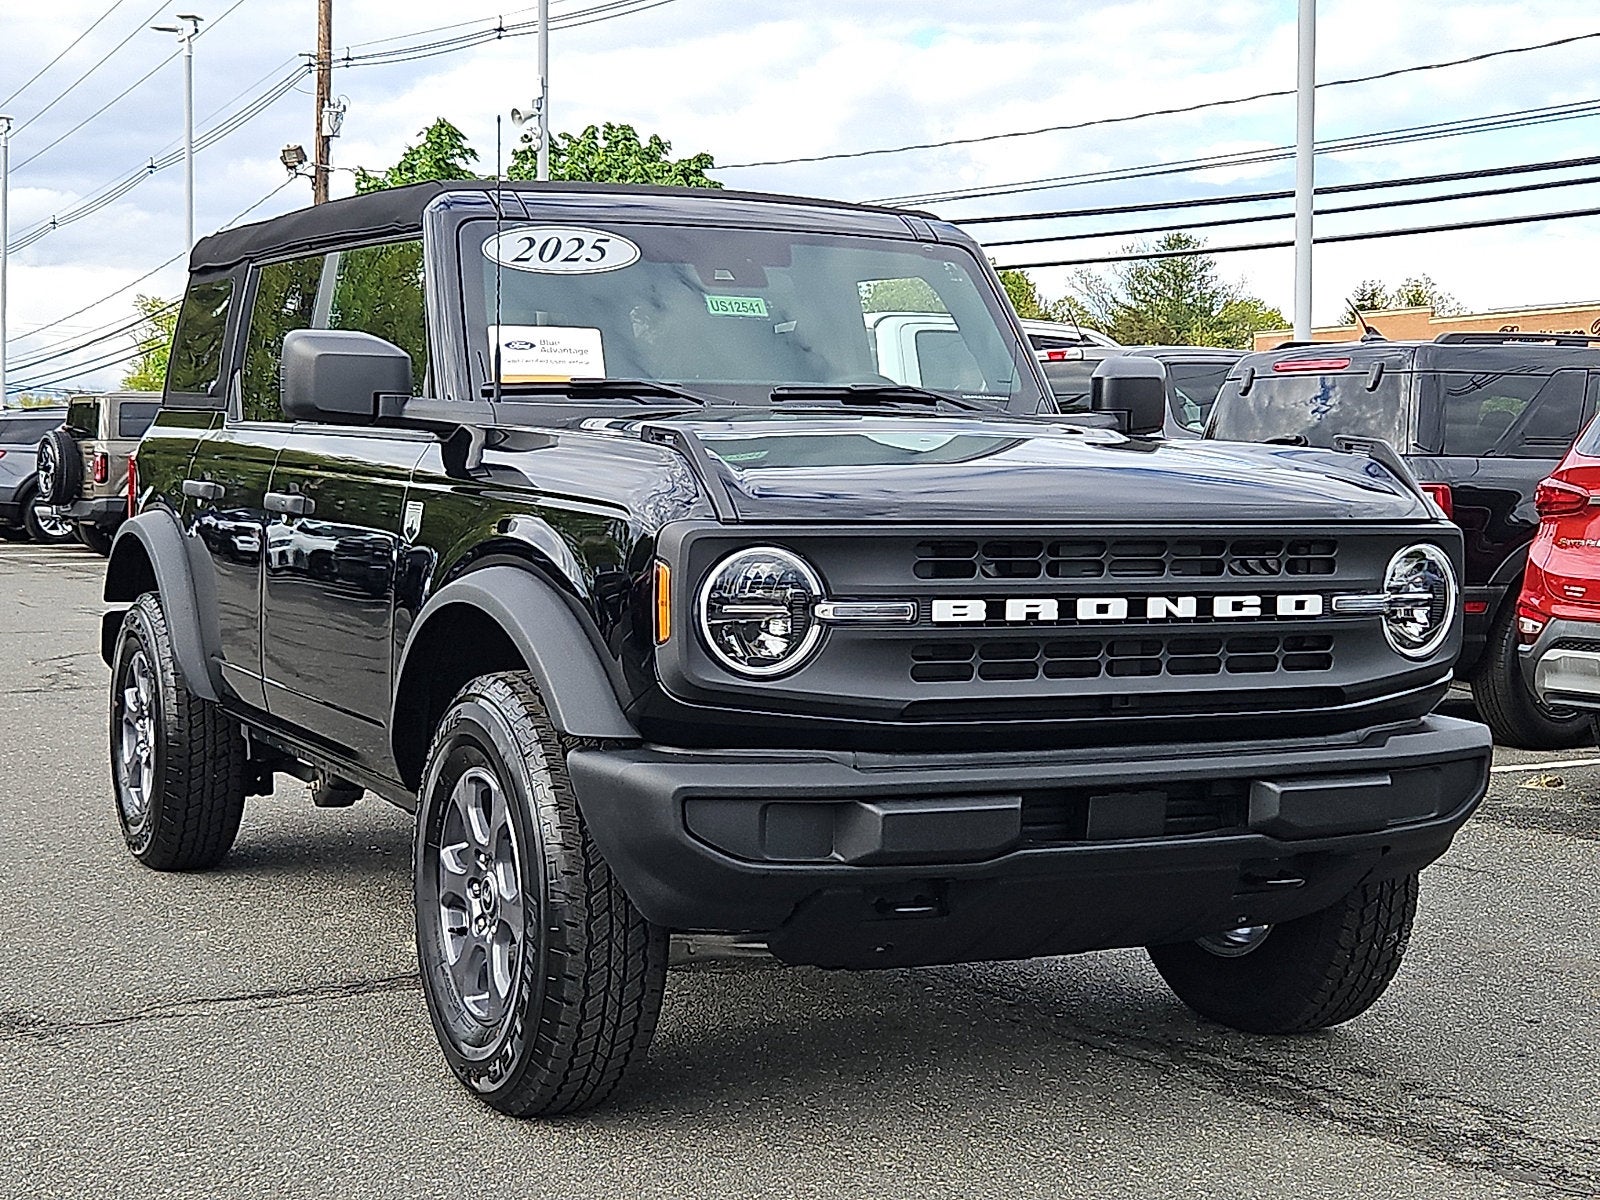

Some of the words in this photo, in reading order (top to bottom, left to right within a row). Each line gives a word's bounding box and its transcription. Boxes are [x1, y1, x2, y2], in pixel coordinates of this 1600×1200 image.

[511, 236, 611, 263] 2025
[710, 299, 763, 314] US12541
[539, 339, 561, 347] Blue
[540, 347, 589, 356] Advantage
[931, 594, 1323, 622] BRONCO
